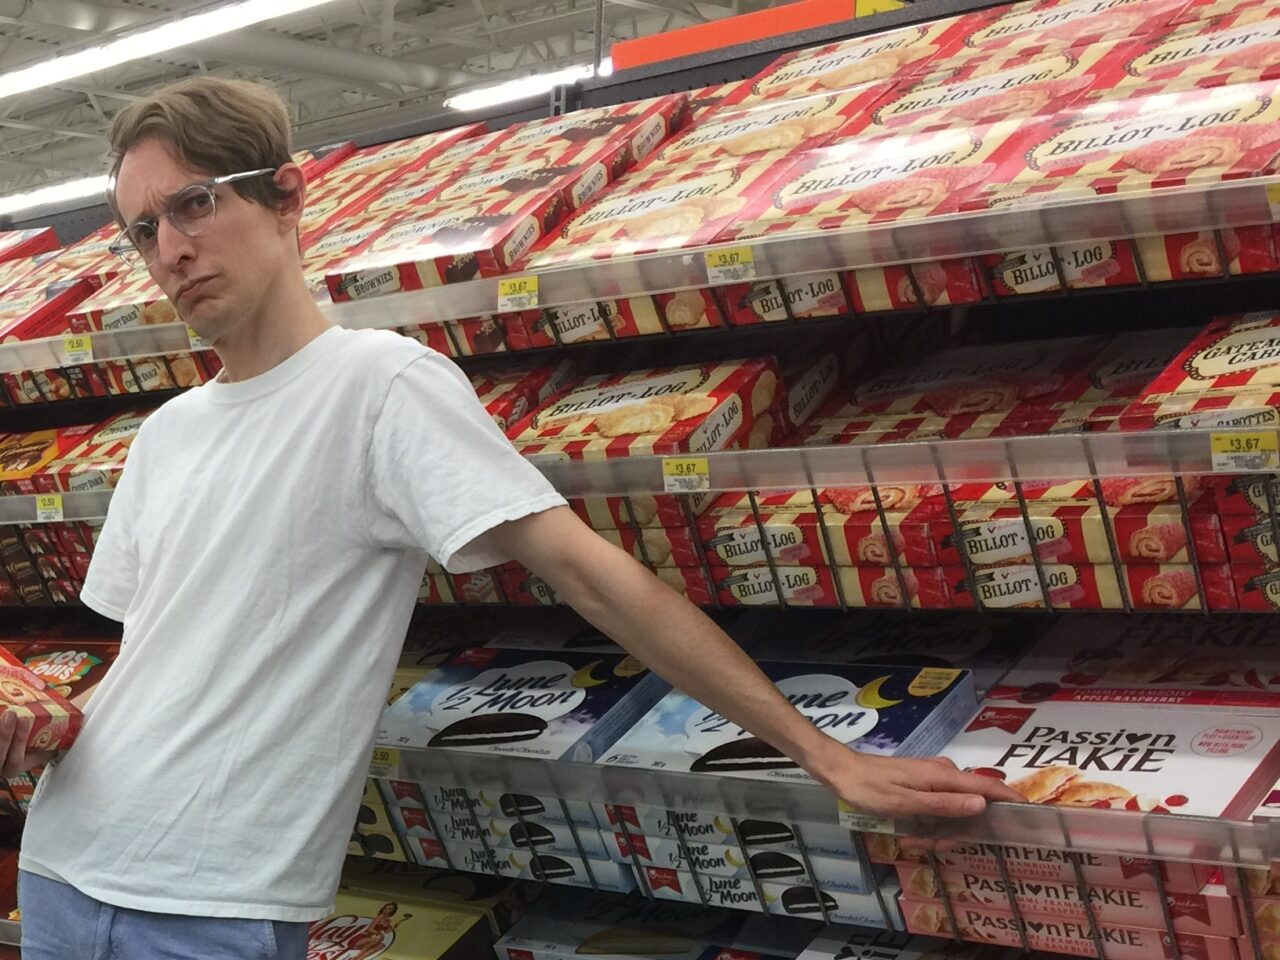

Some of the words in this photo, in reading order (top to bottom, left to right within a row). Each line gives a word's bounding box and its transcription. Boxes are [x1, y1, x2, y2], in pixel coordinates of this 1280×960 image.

[353, 273, 394, 297] BROWNIES
[475, 674, 568, 697] Lune
[472, 690, 573, 713] Moon
[709, 877, 741, 890] Lune
